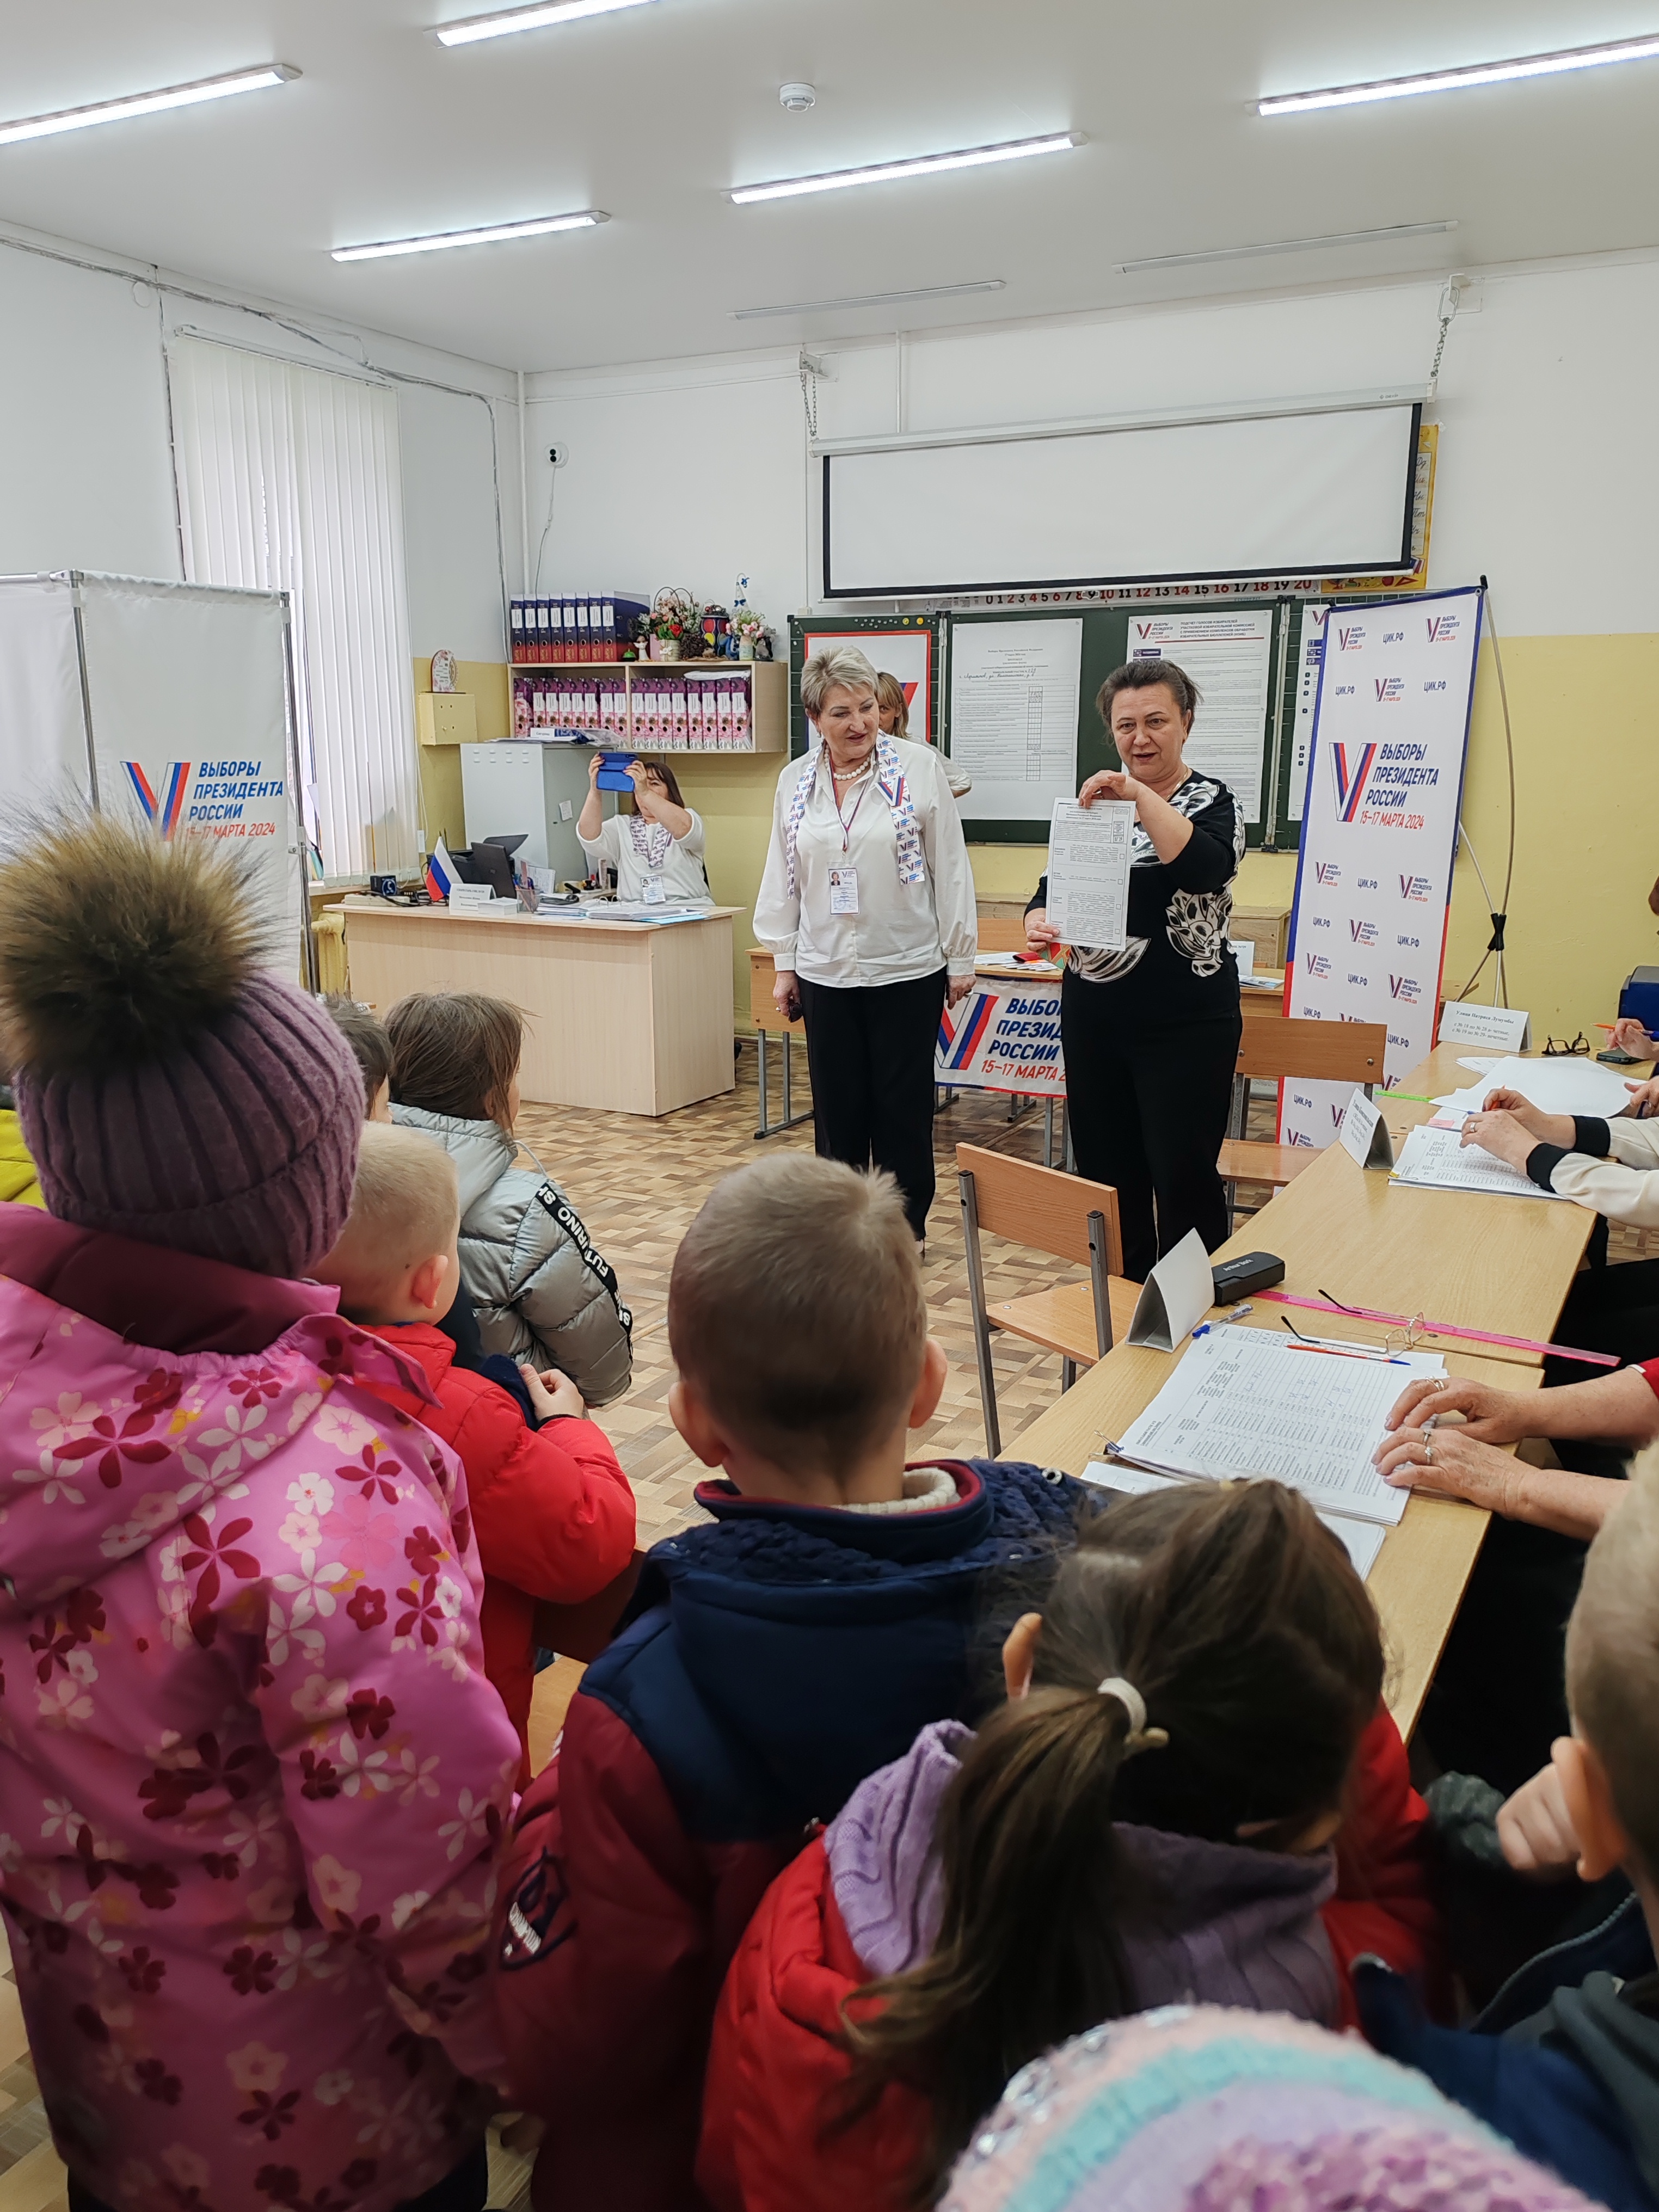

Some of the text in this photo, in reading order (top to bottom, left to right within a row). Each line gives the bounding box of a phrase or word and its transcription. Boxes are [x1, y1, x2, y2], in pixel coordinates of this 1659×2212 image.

[986, 595, 993, 604] 0
[1007, 594, 1014, 603] 2
[1018, 594, 1025, 603] 3
[1029, 594, 1037, 602] 4
[1042, 593, 1048, 601] 5
[1065, 592, 1072, 600] 7
[1076, 592, 1083, 600] 8
[1100, 590, 1114, 599] 10
[1119, 589, 1131, 598] 11
[1136, 588, 1150, 597] 12
[1155, 587, 1169, 597] 13
[1175, 587, 1189, 595] 14
[1194, 586, 1209, 594] 15
[1214, 585, 1229, 593] 16
[1234, 583, 1248, 592] 17
[1254, 582, 1269, 591] 18
[1274, 581, 1289, 590] 19
[1294, 580, 1311, 589] 20
[1383, 632, 1404, 644] ЦИК.РФ
[1335, 685, 1355, 696] ЦИК.РФ
[1424, 680, 1446, 693] ЦИК.РФ
[1379, 744, 1428, 761] ВЫБОРЫ
[199, 761, 261, 778] ВЫБОРЫ
[1372, 766, 1439, 787] ПРЕЗИДЕНТА
[193, 781, 283, 800] ПРЕЗИДЕНТА
[1365, 789, 1408, 807] РОССИИ
[188, 803, 243, 821] РОССИИ
[1379, 812, 1405, 828] МАРТА
[1404, 814, 1424, 830] 2024
[213, 824, 245, 839] МАРТА
[248, 822, 275, 836] 2024
[1357, 877, 1378, 889] ЦИК.РФ
[1313, 916, 1330, 928] ЦИК.РФ
[1397, 935, 1420, 948] ЦИК.РФ
[1348, 973, 1368, 986] ЦИК.РФ
[1005, 998, 1062, 1016] ВЫБО
[1304, 1006, 1321, 1019] ЦИК.РФ
[1387, 1033, 1409, 1048] ЦИК.РФ
[987, 1040, 1060, 1061] РОССИИ
[1014, 1064, 1059, 1081] МАРТА
[1293, 1094, 1312, 1108] ЦИК.РФ
